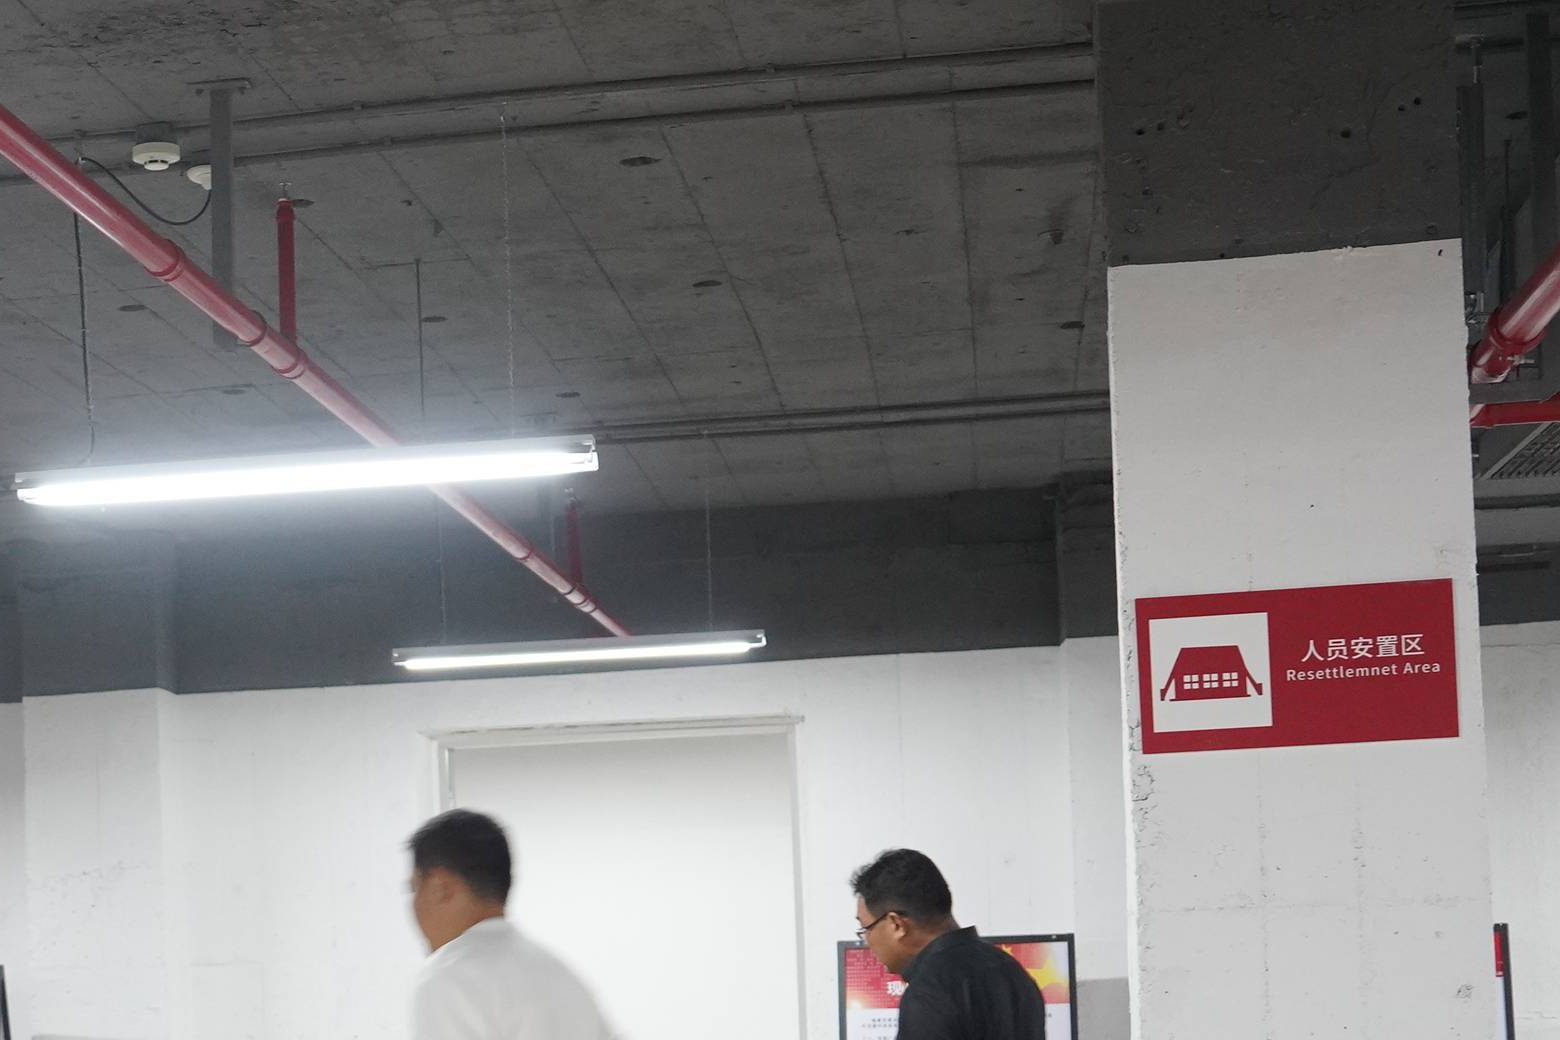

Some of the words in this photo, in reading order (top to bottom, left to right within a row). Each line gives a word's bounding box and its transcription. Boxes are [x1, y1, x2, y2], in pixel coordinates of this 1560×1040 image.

[1300, 633, 1425, 663] 人员安置区
[1286, 663, 1399, 682] Resettlemnet
[1402, 662, 1441, 674] Area
